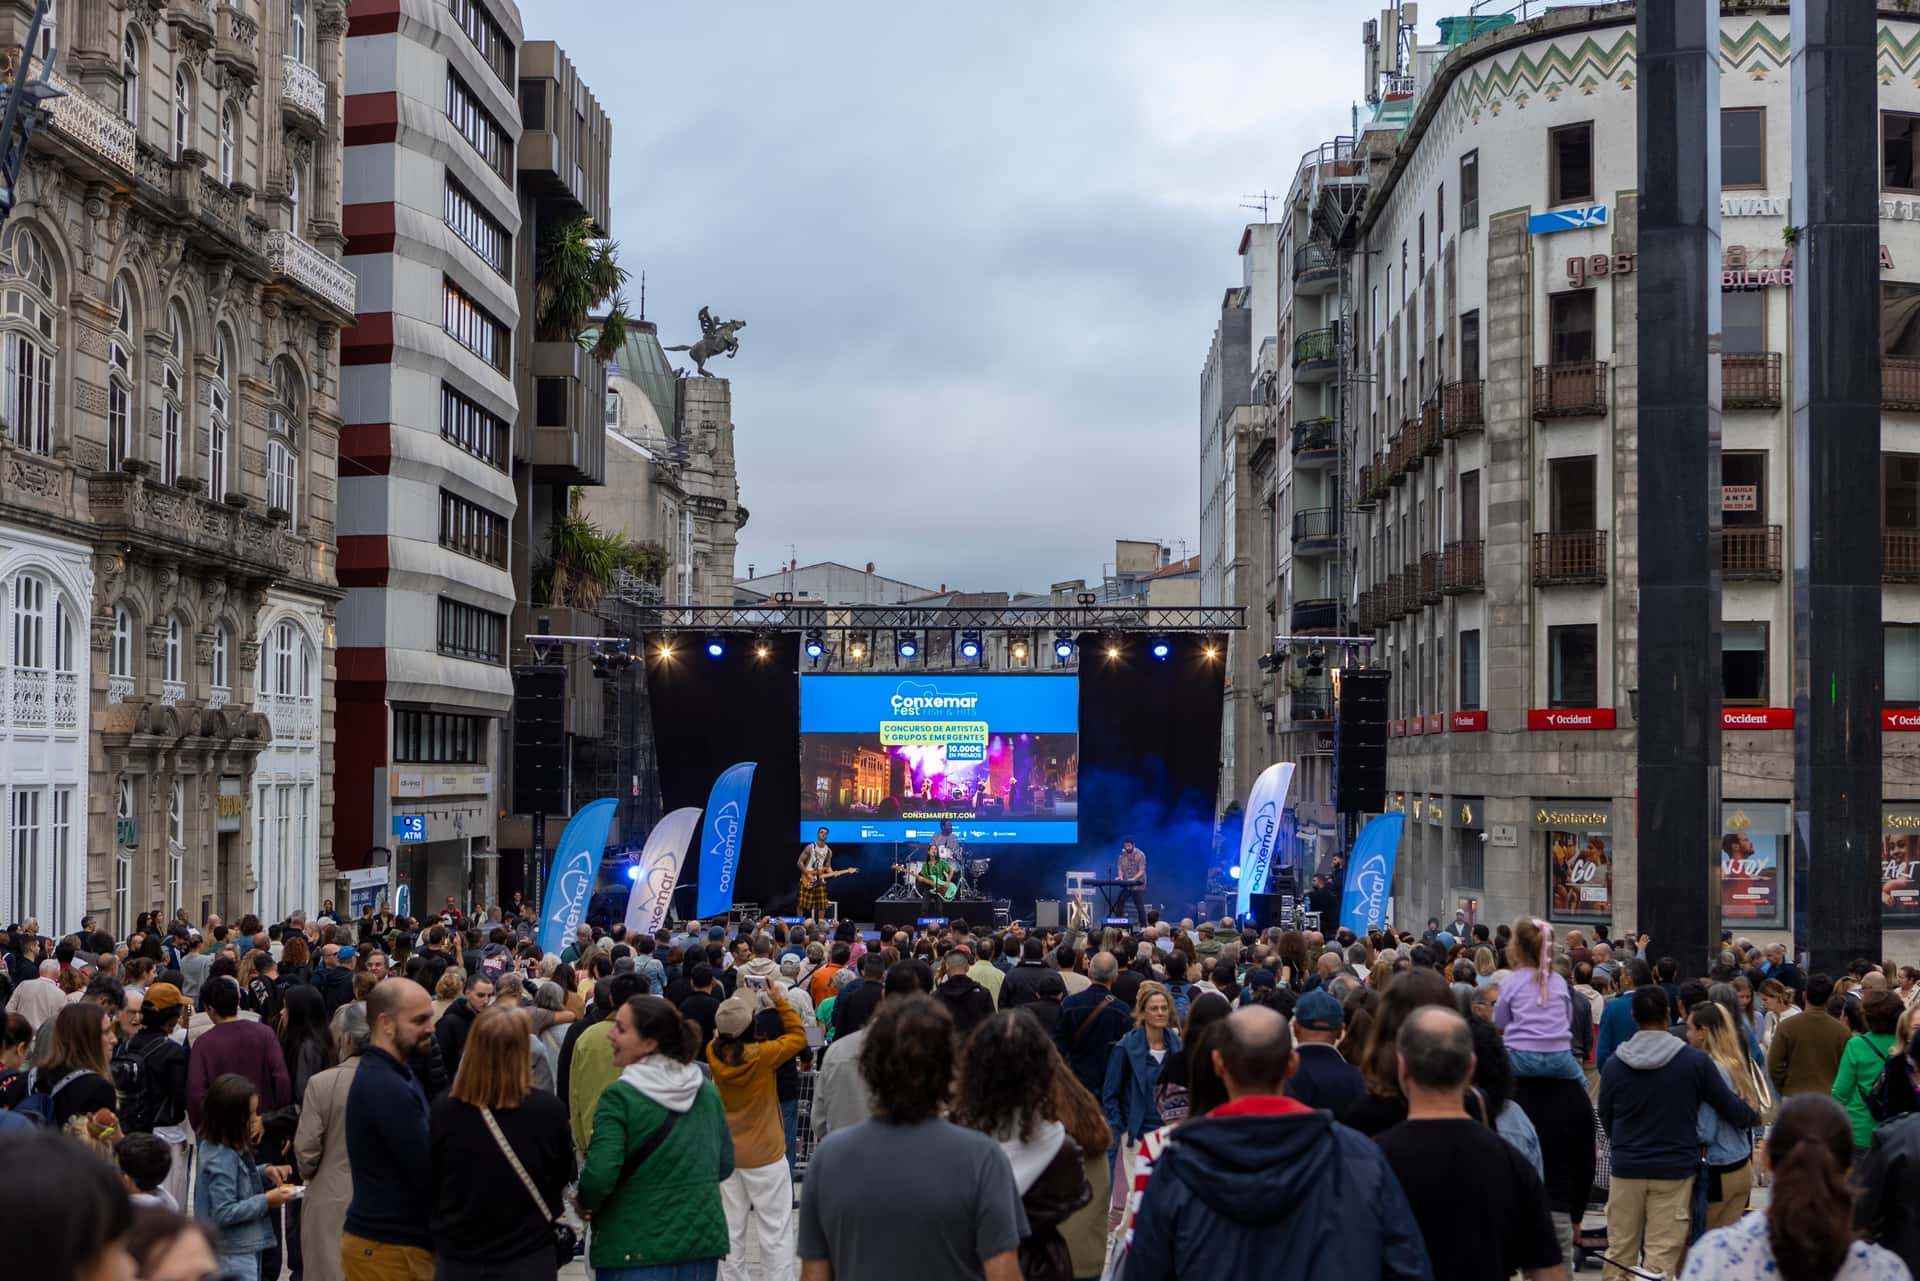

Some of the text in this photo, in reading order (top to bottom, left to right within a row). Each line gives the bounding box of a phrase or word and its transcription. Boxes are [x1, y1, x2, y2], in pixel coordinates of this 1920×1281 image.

[1721, 269, 1793, 286] BILIAR
[890, 694, 978, 708] Conxemar
[893, 706, 920, 716] Fest
[1556, 714, 1593, 724] Occident
[1724, 714, 1768, 723] Occident
[1900, 715, 1920, 725] Occid
[949, 745, 981, 753] 10.000€
[1550, 809, 1608, 824] Santander
[1887, 815, 1920, 828] Santa
[404, 832, 422, 840] ATM
[720, 819, 738, 893] conxemar
[1571, 859, 1597, 883] GO
[1721, 857, 1769, 876] NJOY
[648, 872, 675, 936] nxemar
[1367, 875, 1385, 926] xemar
[561, 875, 589, 948] nxemar
